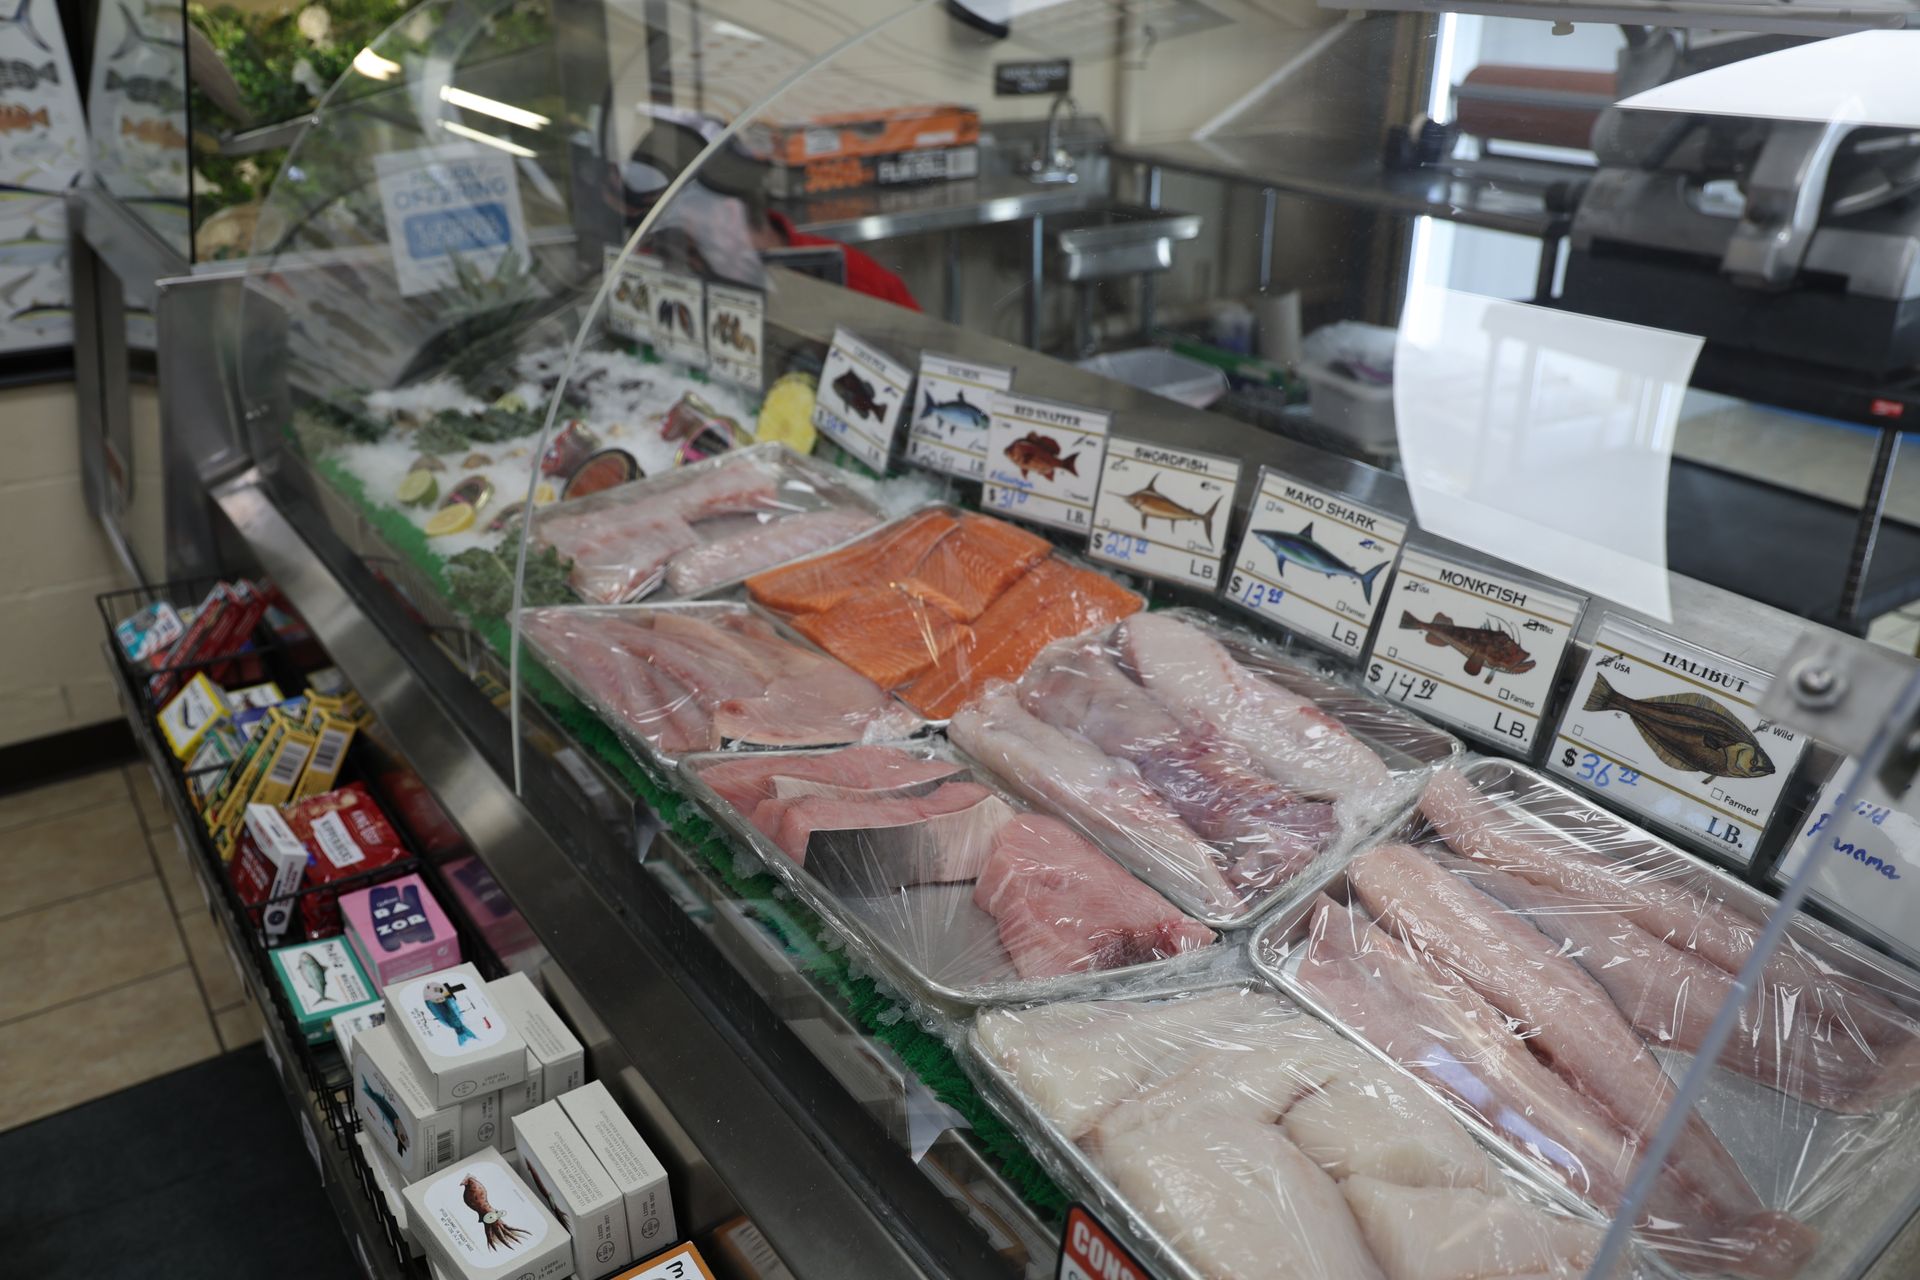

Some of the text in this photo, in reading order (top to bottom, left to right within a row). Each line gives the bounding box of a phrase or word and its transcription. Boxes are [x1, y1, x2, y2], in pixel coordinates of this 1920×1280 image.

[1135, 447, 1208, 472] SWORDFISH
[1285, 487, 1377, 531] MAKO SHARK
[1093, 533, 1103, 550] $
[1190, 559, 1217, 581] LB.
[1230, 576, 1243, 593] $
[1439, 569, 1527, 607] MONKFISH
[1331, 622, 1360, 650] LB.
[1368, 663, 1384, 682] $
[1613, 661, 1631, 675] USA
[1662, 652, 1750, 693] HALIBUT
[1510, 693, 1535, 709] Farmed
[1494, 712, 1528, 742] LB.
[1772, 727, 1795, 742] Wild
[1562, 747, 1578, 768] $
[1724, 794, 1759, 817] Farmed
[1705, 816, 1743, 848] LB.
[377, 914, 426, 936] ZOR
